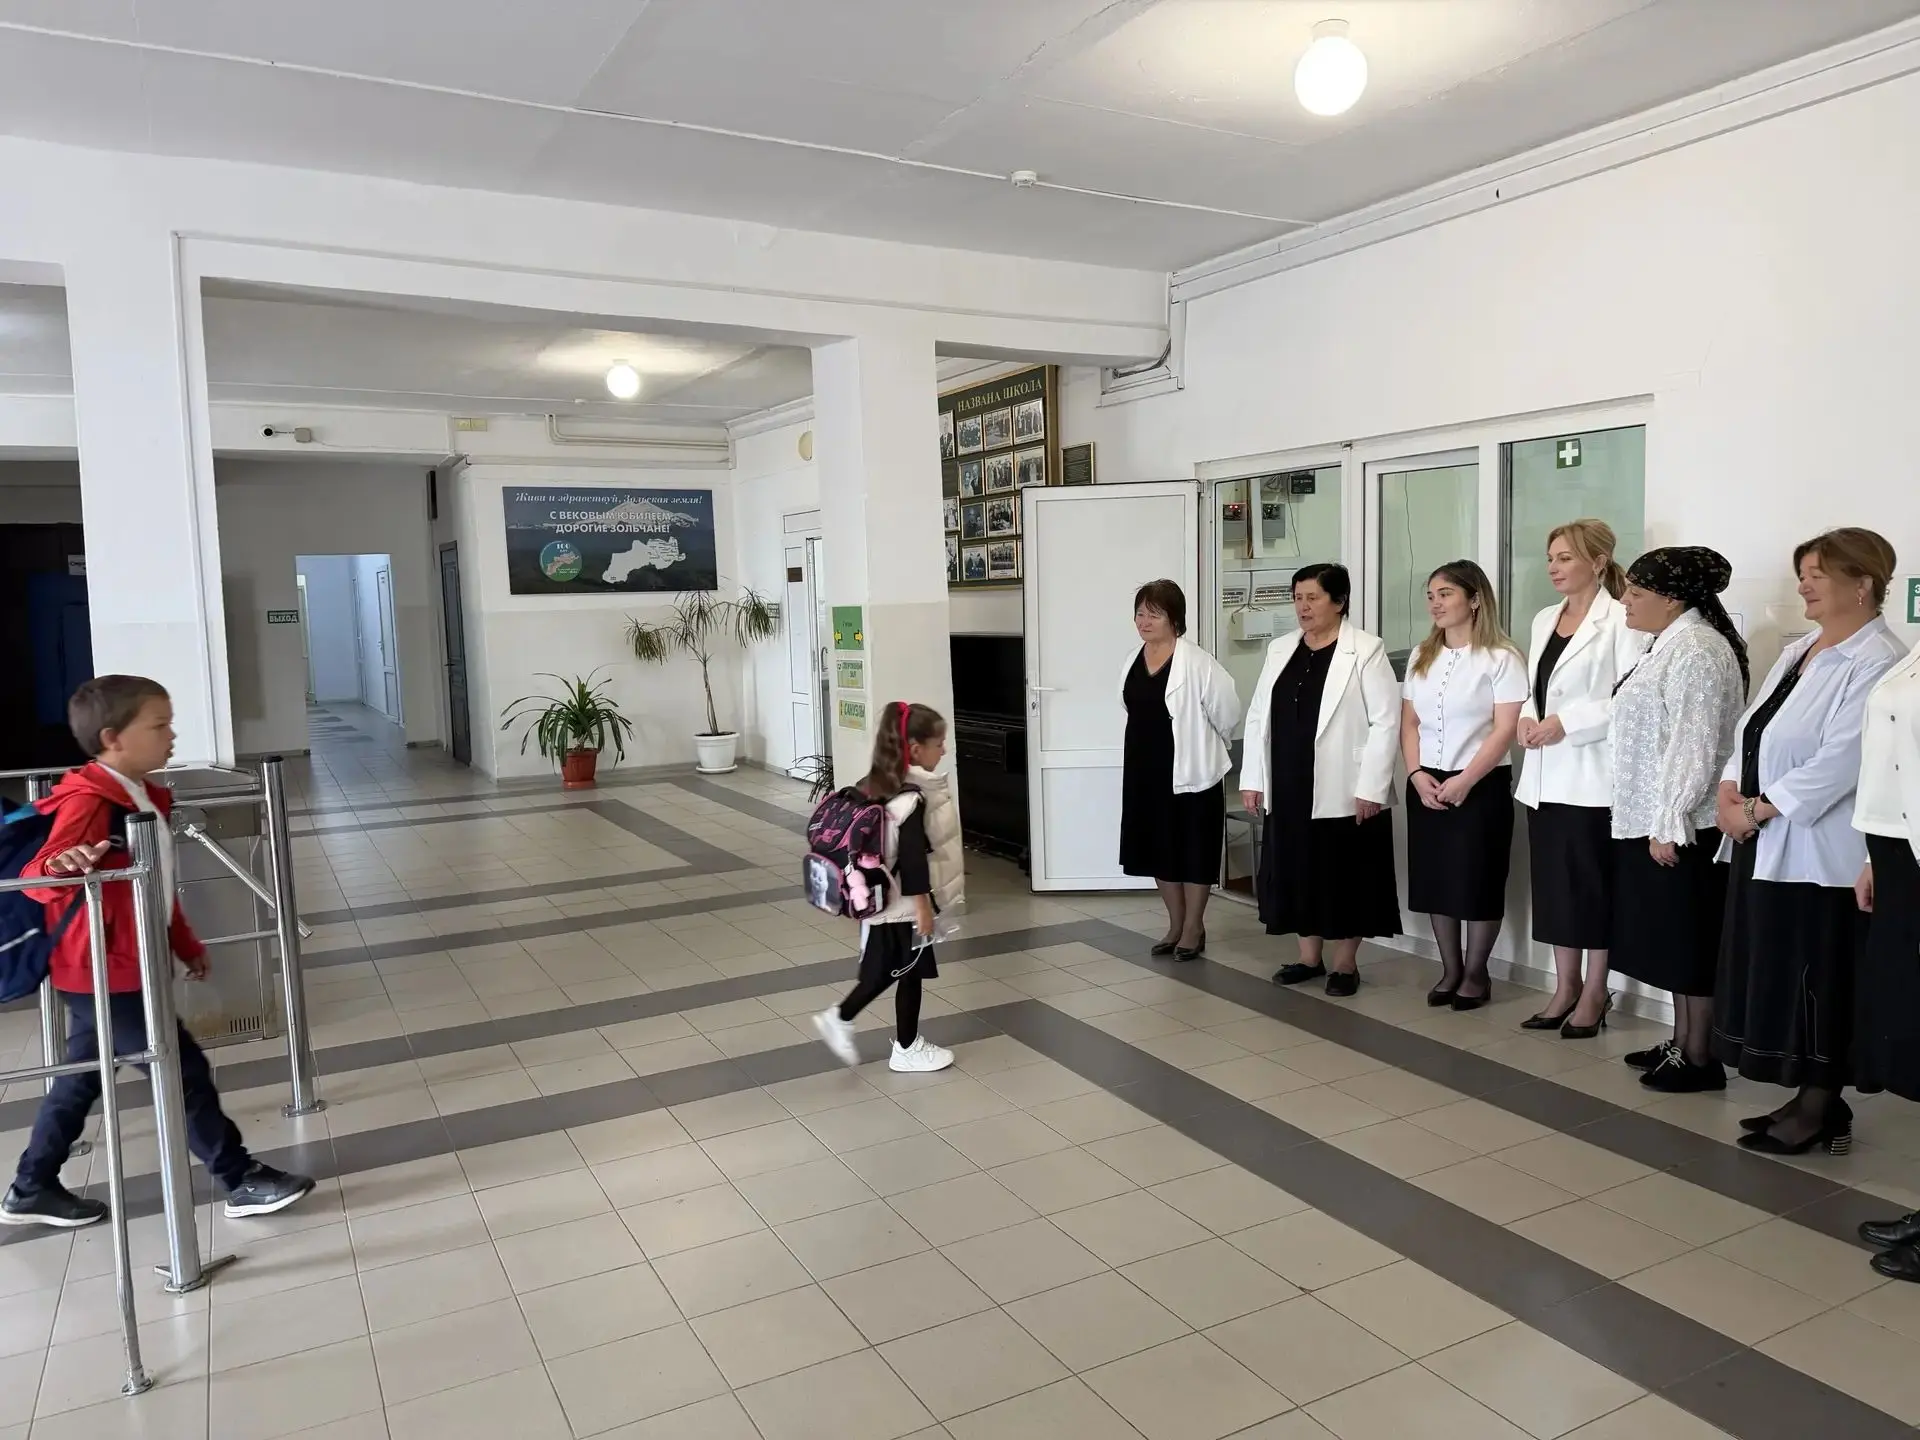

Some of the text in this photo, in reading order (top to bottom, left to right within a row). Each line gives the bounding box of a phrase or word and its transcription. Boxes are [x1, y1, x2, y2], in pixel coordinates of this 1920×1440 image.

[958, 378, 1042, 412] НАЗВАНА ШКОЛА
[515, 492, 546, 502] Живи
[670, 495, 702, 504] земля!
[549, 511, 557, 520] С
[559, 511, 615, 520] ВЕКОВЫМ
[555, 523, 670, 534] ДОРОГИЕ ЗОЛЬЧАНЕ!
[269, 615, 297, 623] ВЫХОД
